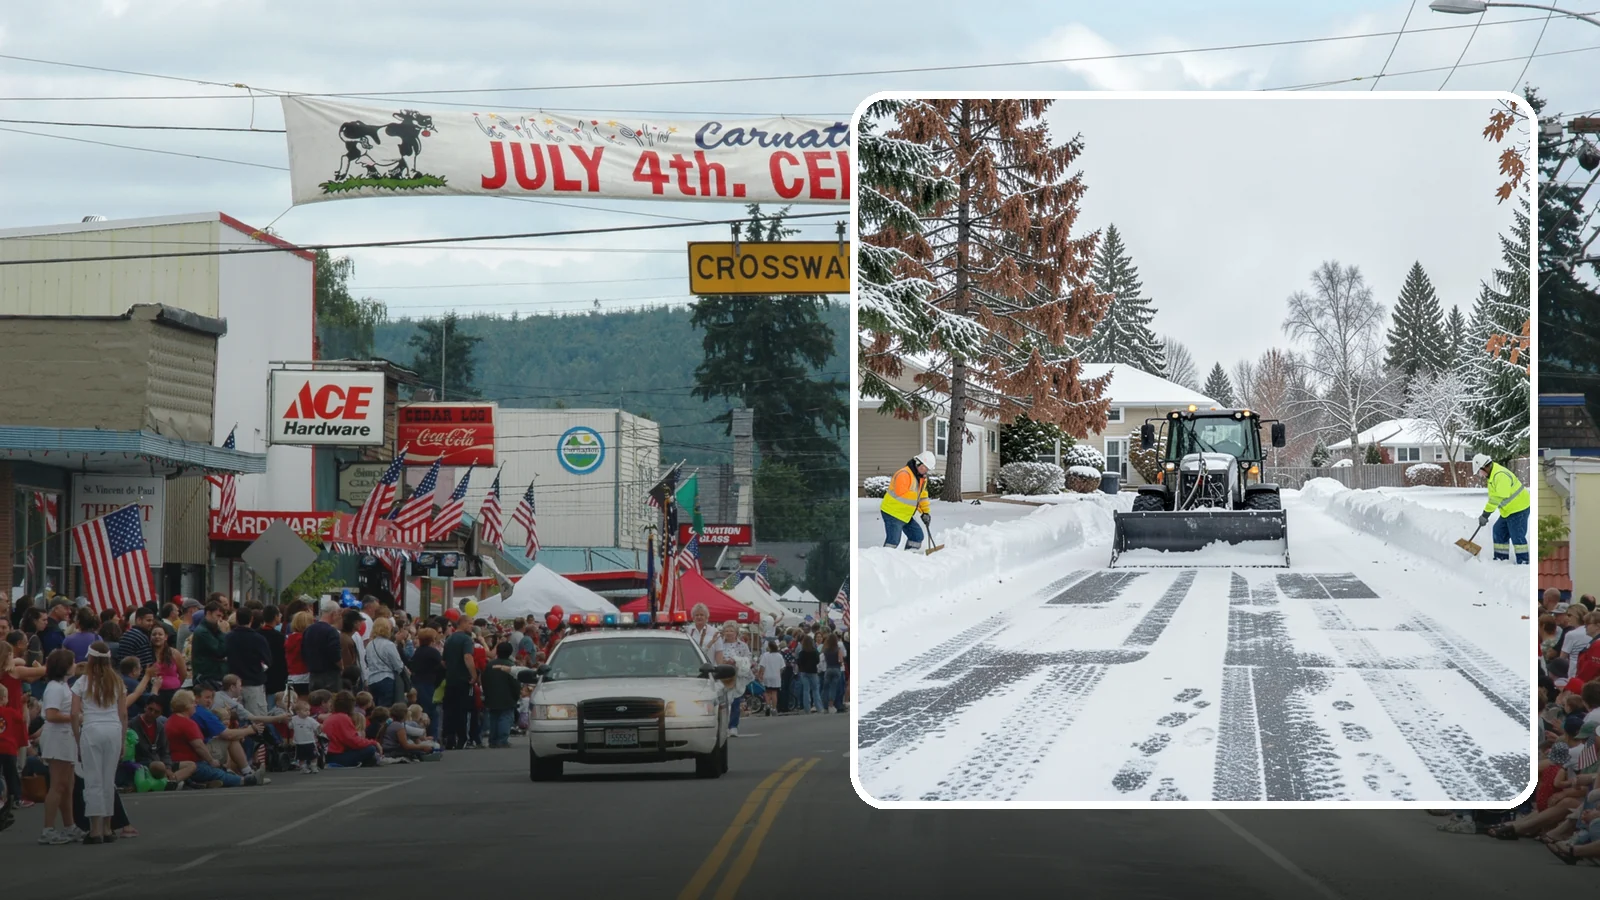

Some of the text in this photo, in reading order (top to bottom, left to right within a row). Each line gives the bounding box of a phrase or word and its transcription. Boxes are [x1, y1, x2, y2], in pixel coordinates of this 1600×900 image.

[481, 141, 604, 193] JULY
[632, 150, 747, 197] 4th.
[697, 254, 850, 280] CROSSWA
[283, 380, 374, 420] ACE
[405, 409, 485, 421] CEDAR LOG
[283, 421, 371, 436] Hardware
[416, 428, 477, 447] Coca-Cola
[353, 467, 385, 479] Simpl
[83, 485, 155, 495] St. Vincent de Paul
[212, 515, 331, 535] HARDARE
[688, 526, 741, 535] CRNATION
[699, 535, 731, 543] GLASS
